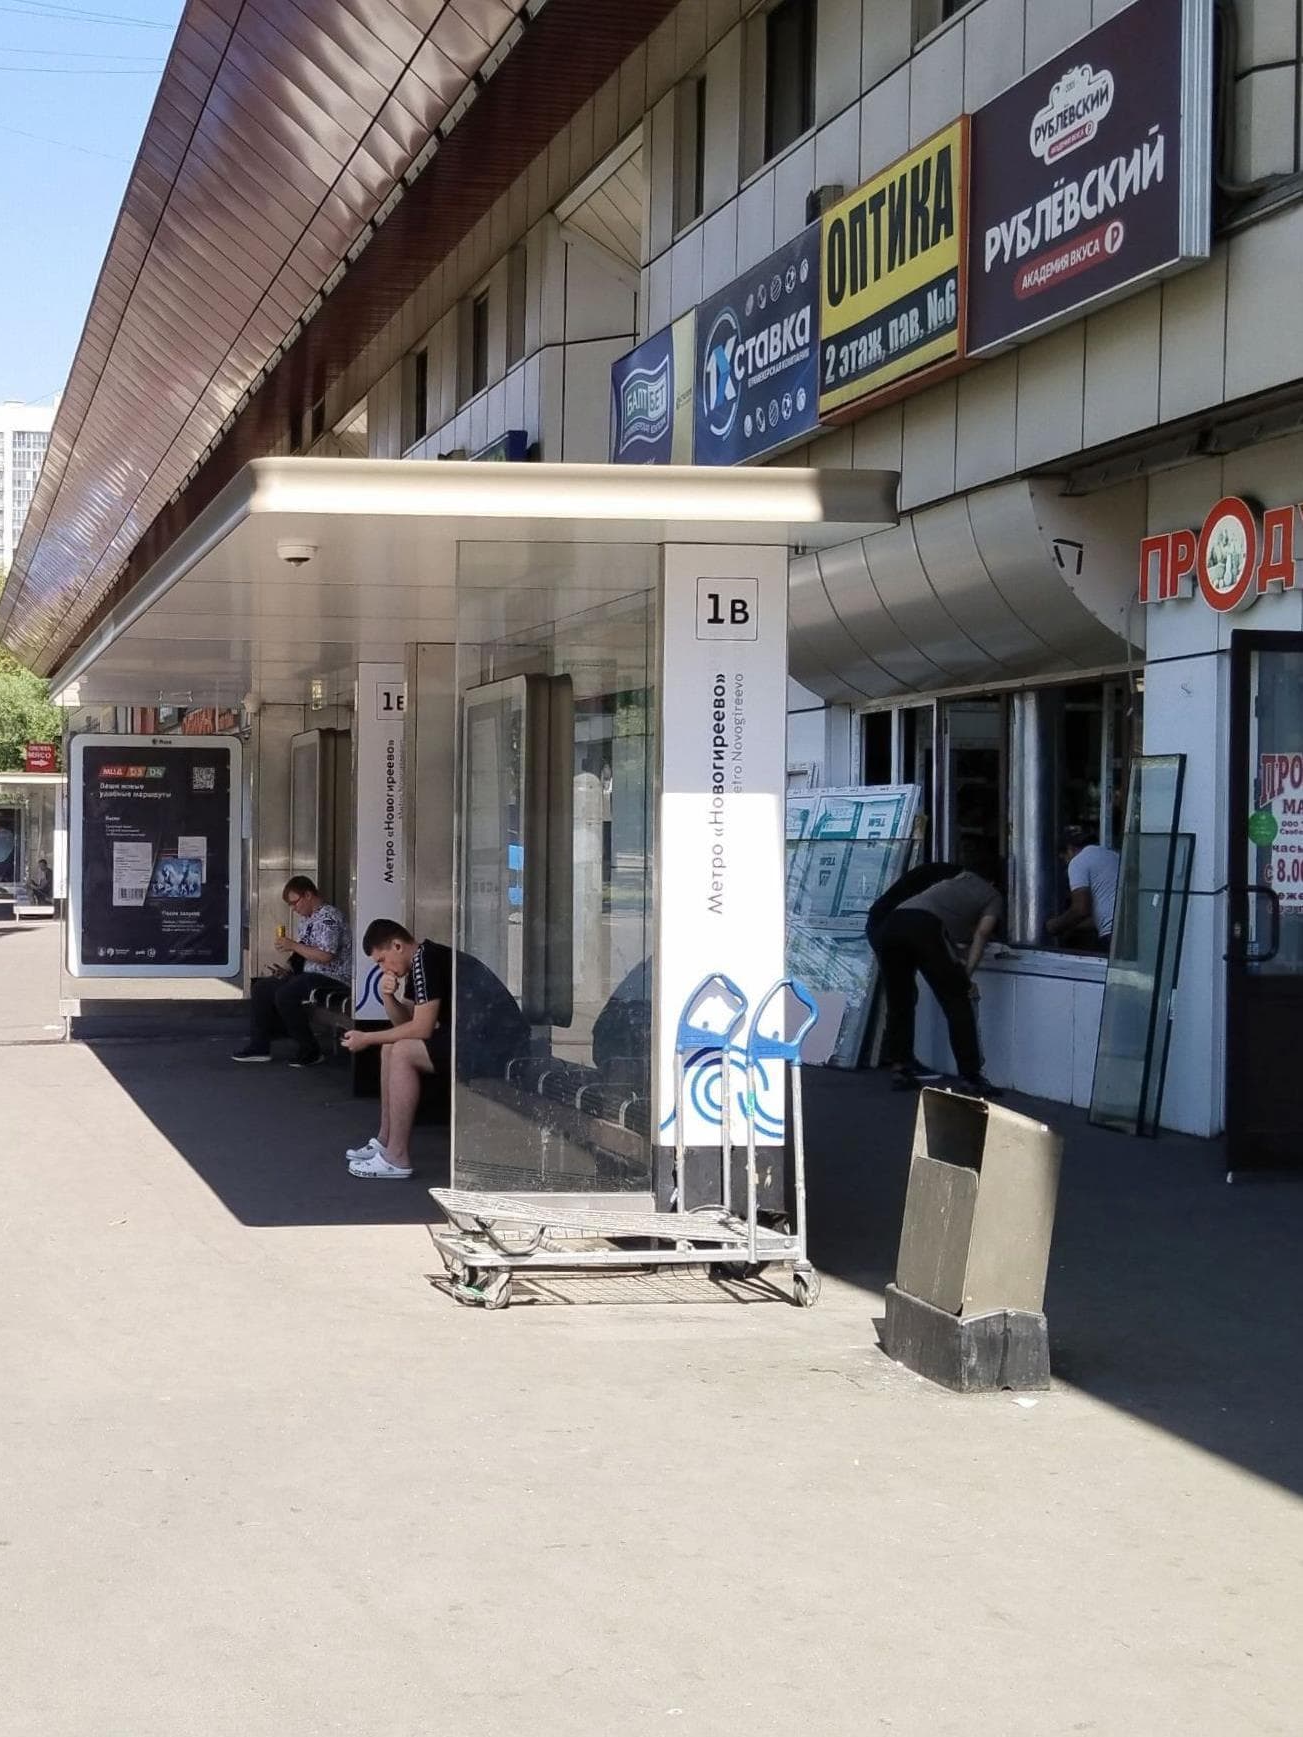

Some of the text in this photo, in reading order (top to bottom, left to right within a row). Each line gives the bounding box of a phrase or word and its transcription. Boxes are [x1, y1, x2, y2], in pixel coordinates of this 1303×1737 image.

[827, 144, 954, 308] ОПТИКА
[984, 124, 1165, 273] РУБЛЁВСКИЙ
[1021, 253, 1069, 290] АКАДЕМИЯ
[1070, 240, 1101, 267] ВКУСА
[825, 344, 835, 385] 2
[1139, 496, 1303, 612] ПРОД
[731, 673, 746, 793] etro Novogireevo
[707, 674, 729, 914] Метро «Новогиреево»
[384, 841, 397, 884] Метро
